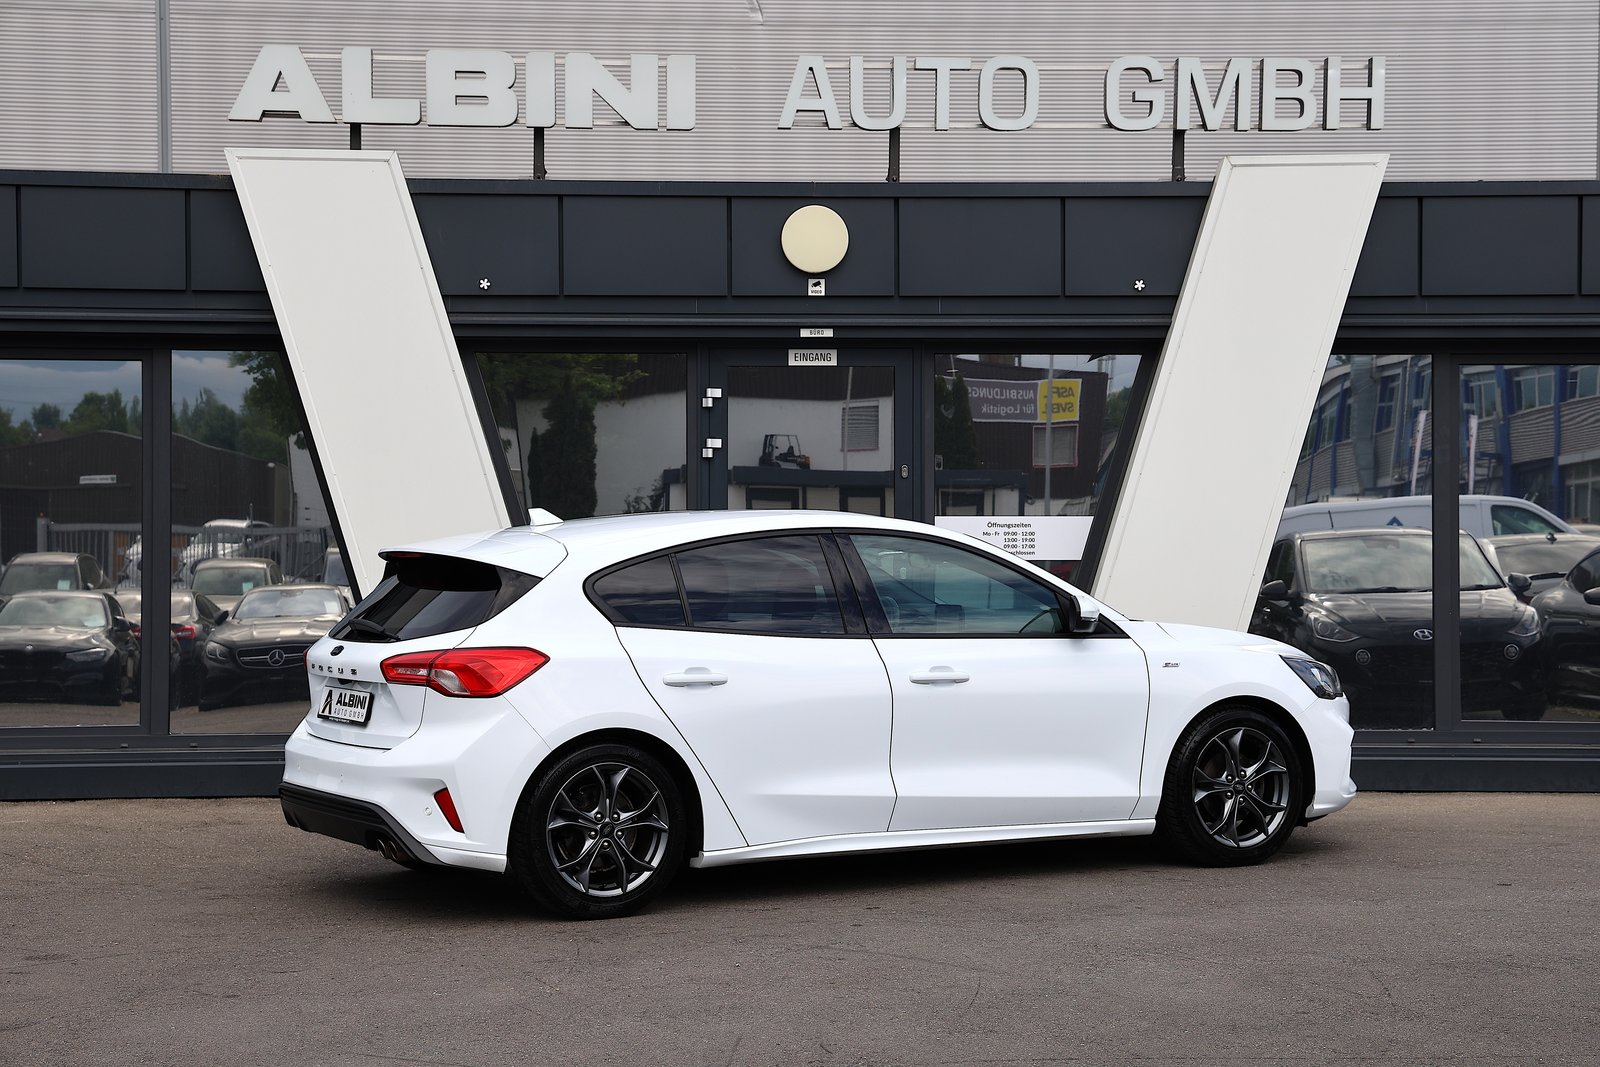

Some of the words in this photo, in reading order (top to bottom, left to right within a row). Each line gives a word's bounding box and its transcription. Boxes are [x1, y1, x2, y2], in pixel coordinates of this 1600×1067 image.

[229, 45, 697, 131] ALBINI
[778, 55, 1041, 131] AUTO
[1104, 55, 1387, 132] GMBH
[794, 352, 832, 362] EINGANG
[987, 521, 1031, 529] Öffnungszeiten
[311, 663, 358, 675] FOCUS
[335, 692, 368, 710] ALBINI
[333, 708, 347, 717] AUTO
[348, 710, 365, 720] GMBH
